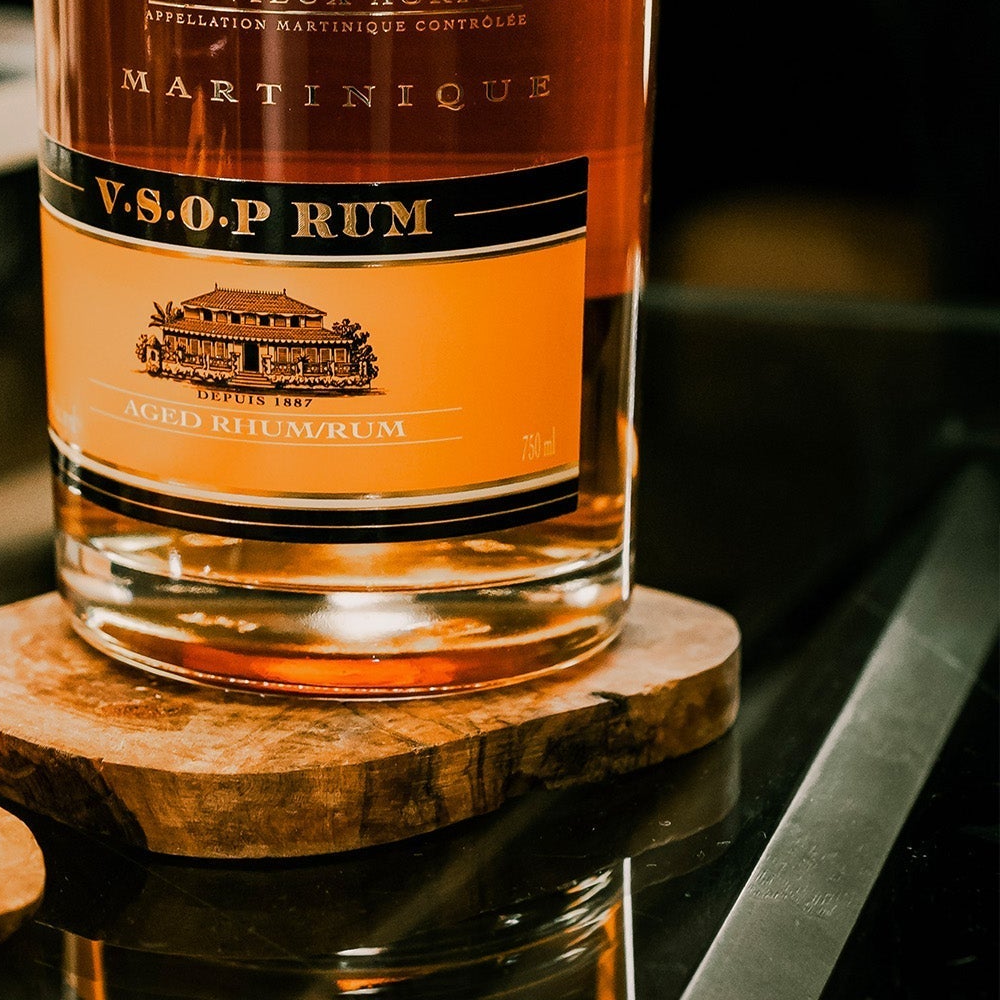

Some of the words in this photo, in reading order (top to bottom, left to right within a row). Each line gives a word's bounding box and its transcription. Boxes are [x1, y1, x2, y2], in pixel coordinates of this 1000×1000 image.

[145, 9, 267, 30] APPELLATION
[276, 19, 407, 36] MARTINIQUE
[415, 13, 528, 33] CONTRÔLÉE
[120, 67, 552, 113] MARTINIQUE
[290, 198, 433, 240] RUM
[197, 389, 267, 406] DEPUIS
[274, 396, 314, 409] 1887
[123, 399, 203, 429] AGED
[211, 414, 408, 440] RHUM/RUM
[521, 432, 541, 462] 750
